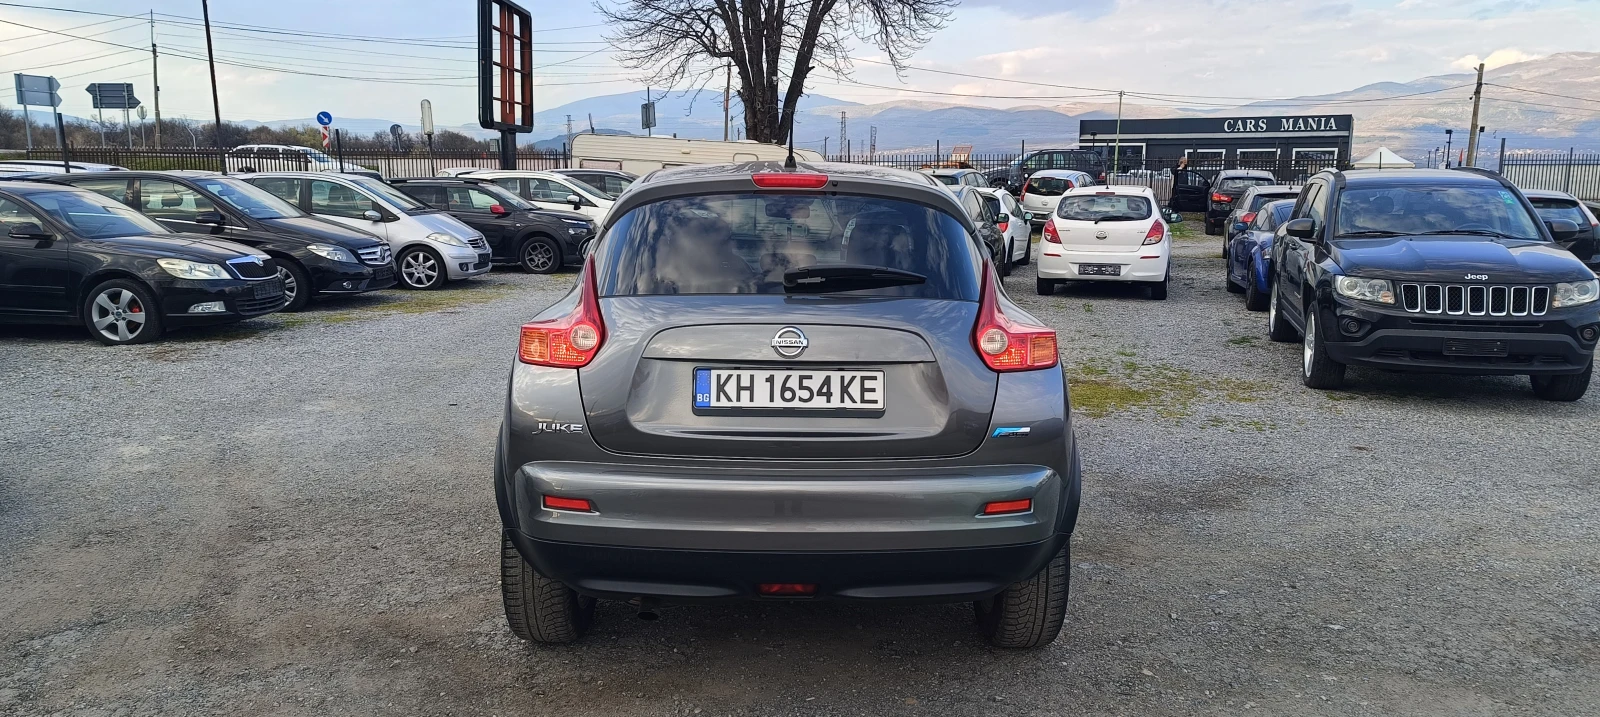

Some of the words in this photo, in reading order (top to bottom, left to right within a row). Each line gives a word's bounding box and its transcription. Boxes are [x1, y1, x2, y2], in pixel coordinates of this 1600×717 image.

[1223, 119, 1267, 132] CARS
[1280, 117, 1338, 131] MANIA
[1464, 273, 1489, 281] Jeep
[716, 373, 755, 403] KH
[764, 374, 833, 403] 1654
[839, 375, 879, 404] KE
[696, 394, 710, 402] BG
[531, 422, 584, 434] JUKE
